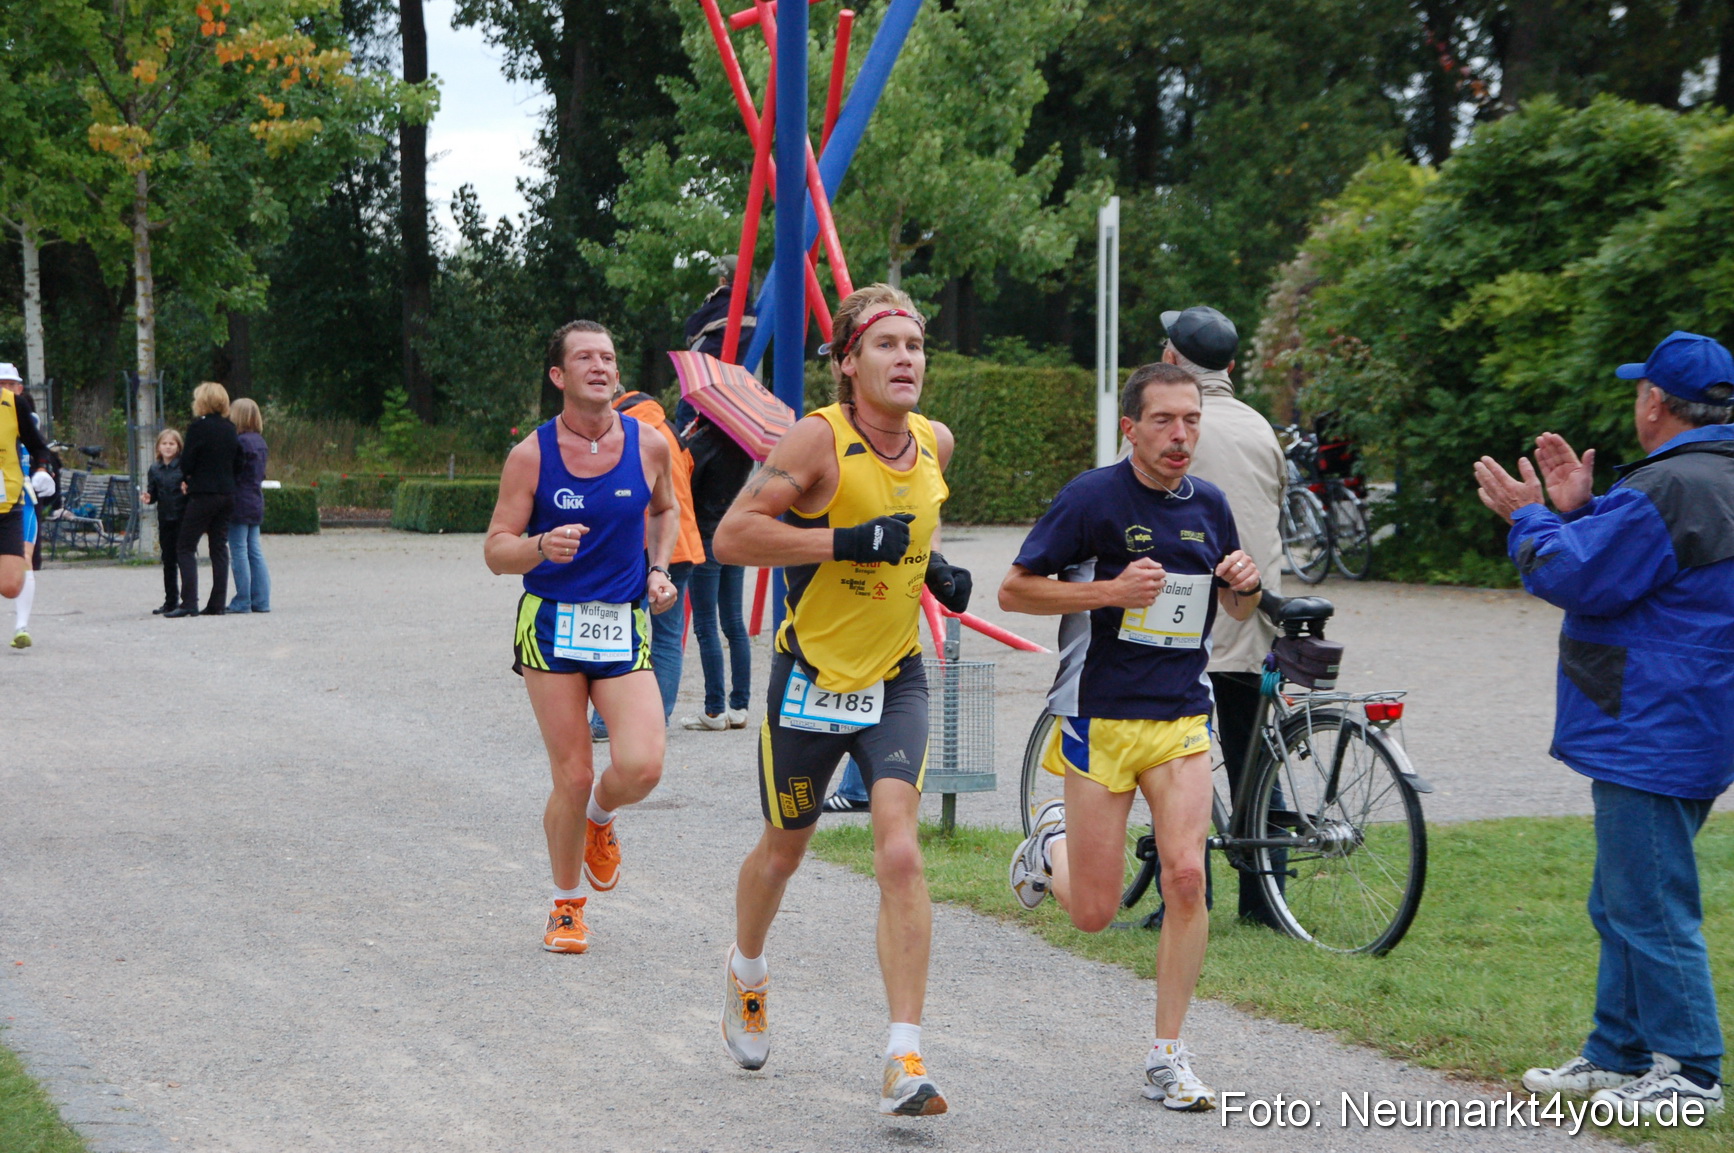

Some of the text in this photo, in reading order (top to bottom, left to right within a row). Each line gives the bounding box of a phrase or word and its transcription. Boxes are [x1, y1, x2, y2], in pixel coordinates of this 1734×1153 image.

[580, 603, 619, 621] Wolfgang
[1172, 604, 1186, 624] 5
[561, 620, 567, 629] A
[579, 622, 623, 641] 2612
[794, 684, 801, 692] A
[814, 691, 875, 713] 2185
[793, 781, 813, 811] Run!
